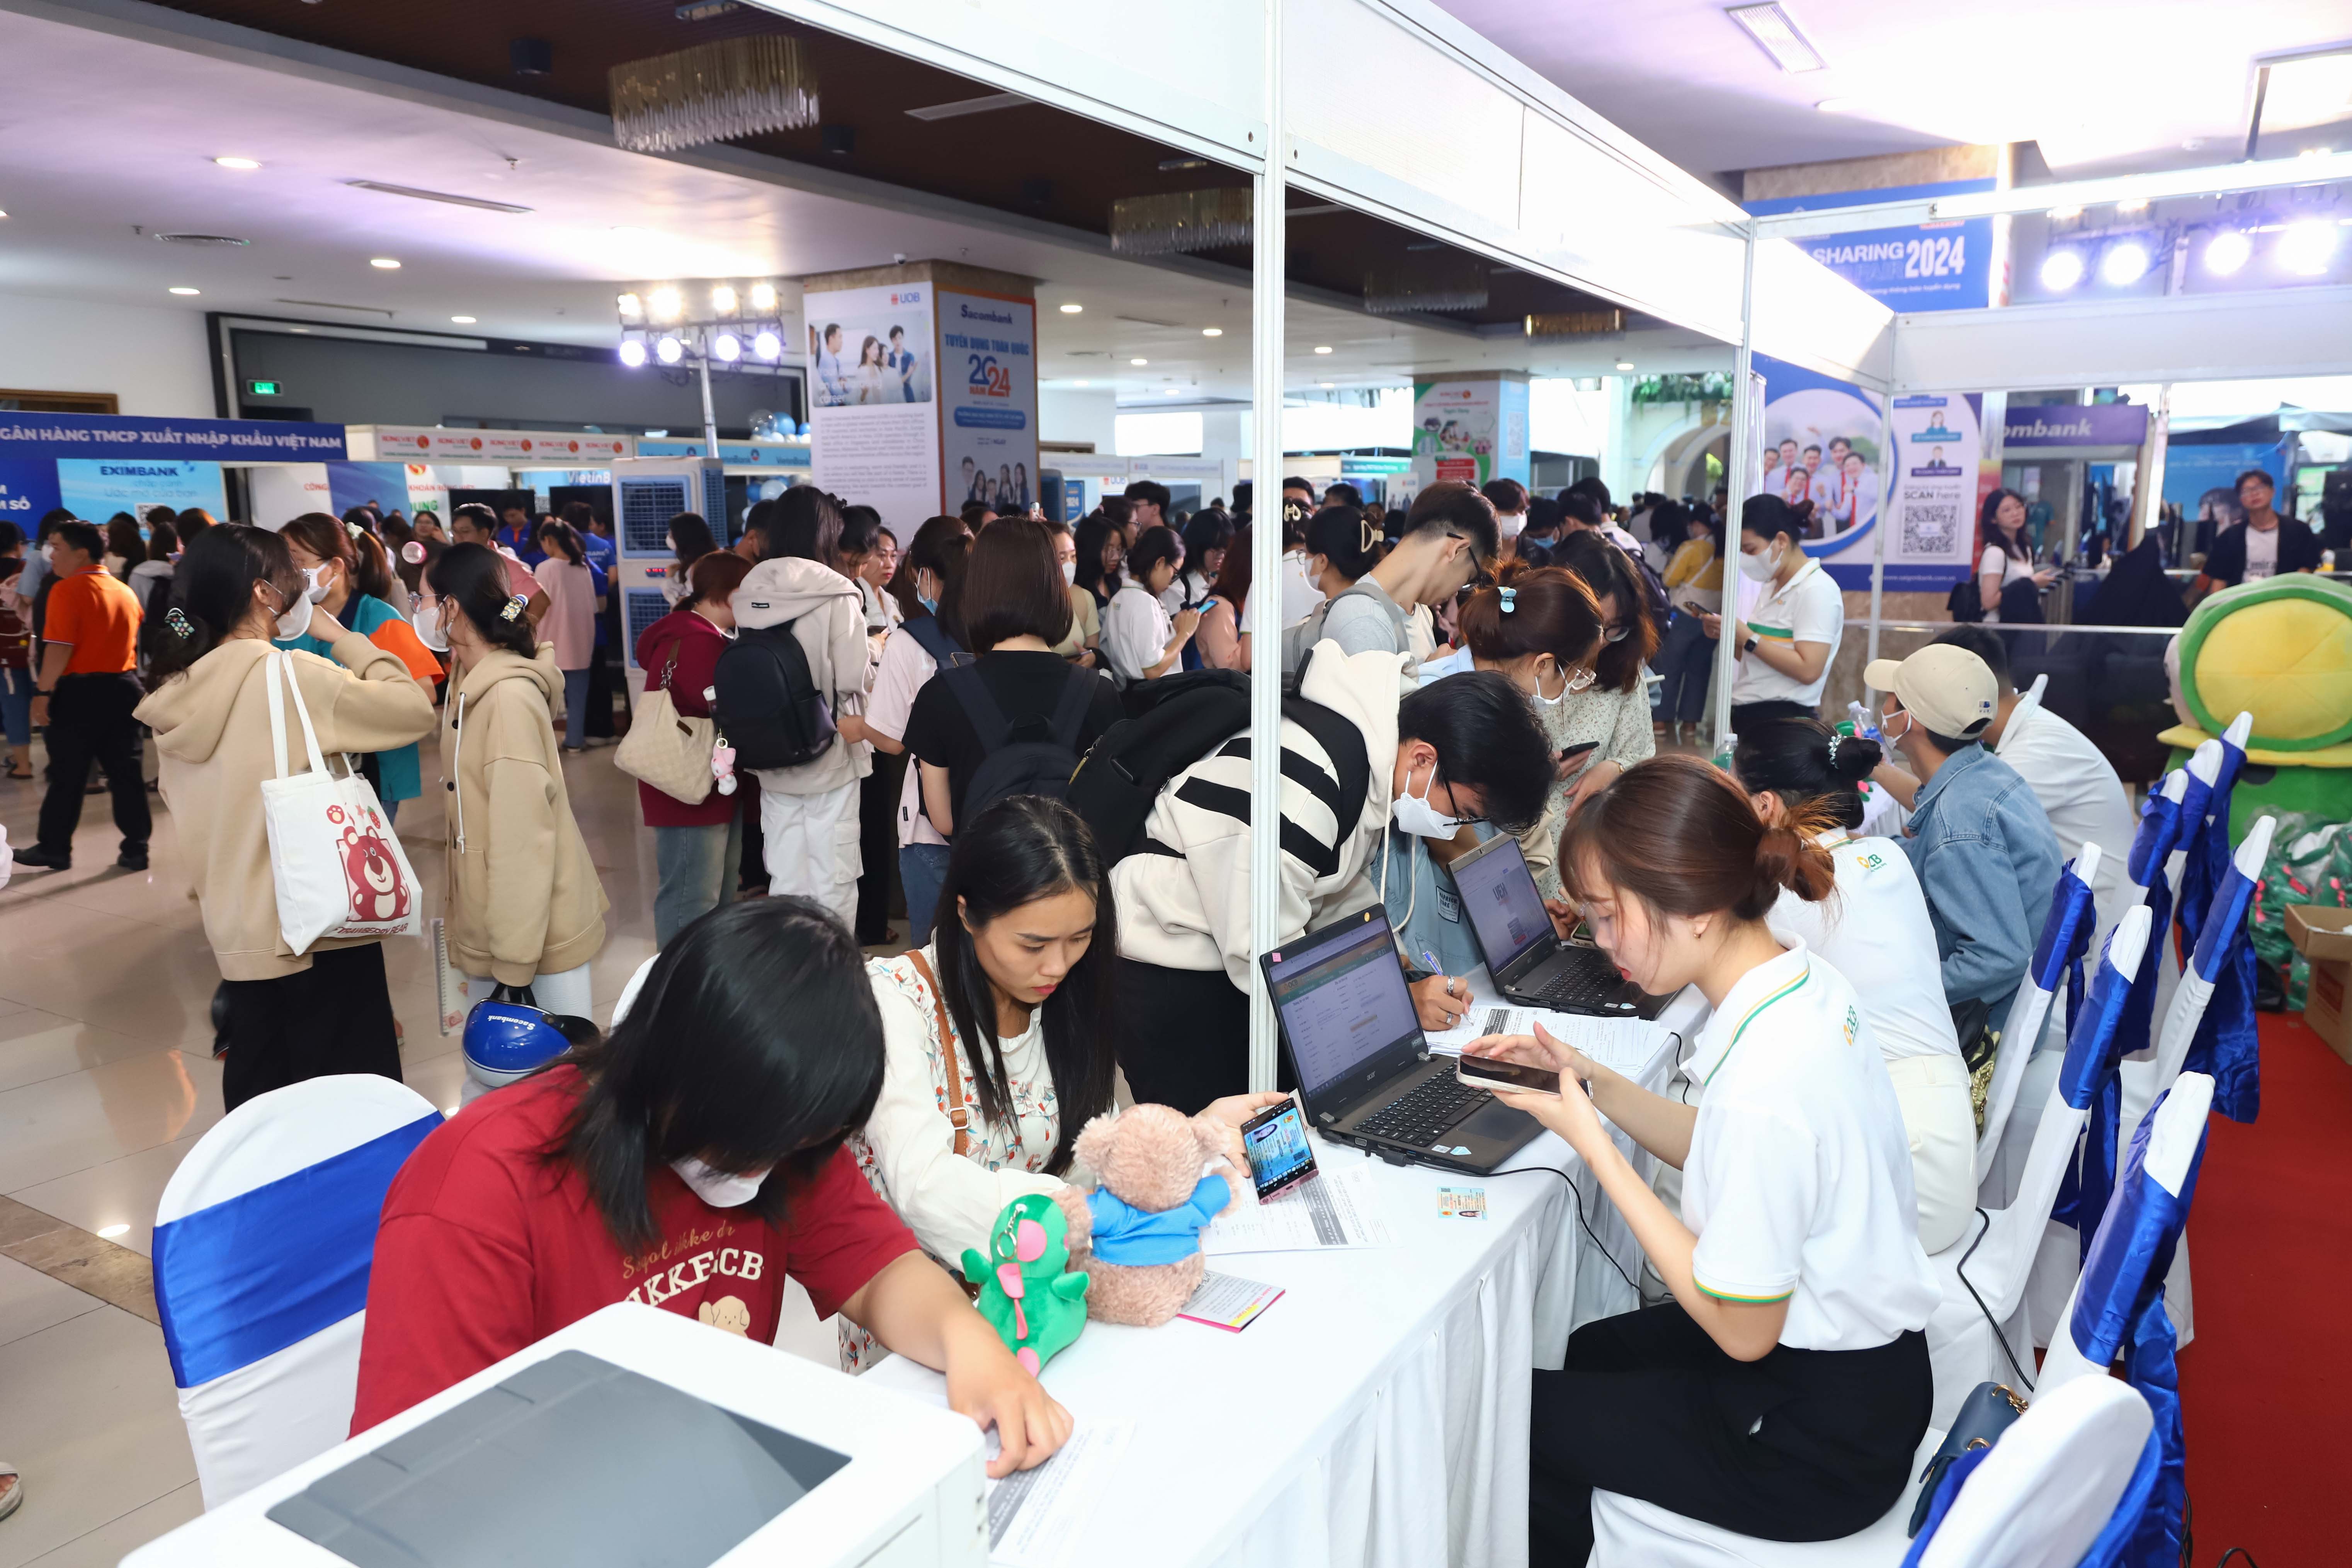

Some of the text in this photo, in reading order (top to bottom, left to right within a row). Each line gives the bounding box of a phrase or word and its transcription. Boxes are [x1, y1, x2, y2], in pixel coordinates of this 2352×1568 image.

[1813, 235, 1965, 278] SHARING 2024
[900, 292, 920, 303] UOB
[961, 304, 1012, 324] Sacombank
[40, 426, 90, 442] HÀNG
[92, 430, 138, 443] TMCP
[141, 427, 183, 444] XUẤT
[185, 430, 228, 448] NHẬP
[232, 429, 272, 446] KHẨU
[275, 433, 307, 451] VIỆT
[309, 437, 342, 448] NAM
[100, 466, 179, 476] EXIMBANK
[1905, 491, 1934, 499] SCAN
[9, 496, 31, 510] SỐ
[1493, 882, 1507, 901] UEH
[488, 1015, 535, 1030] Sacombank
[1367, 1071, 1376, 1081] acer
